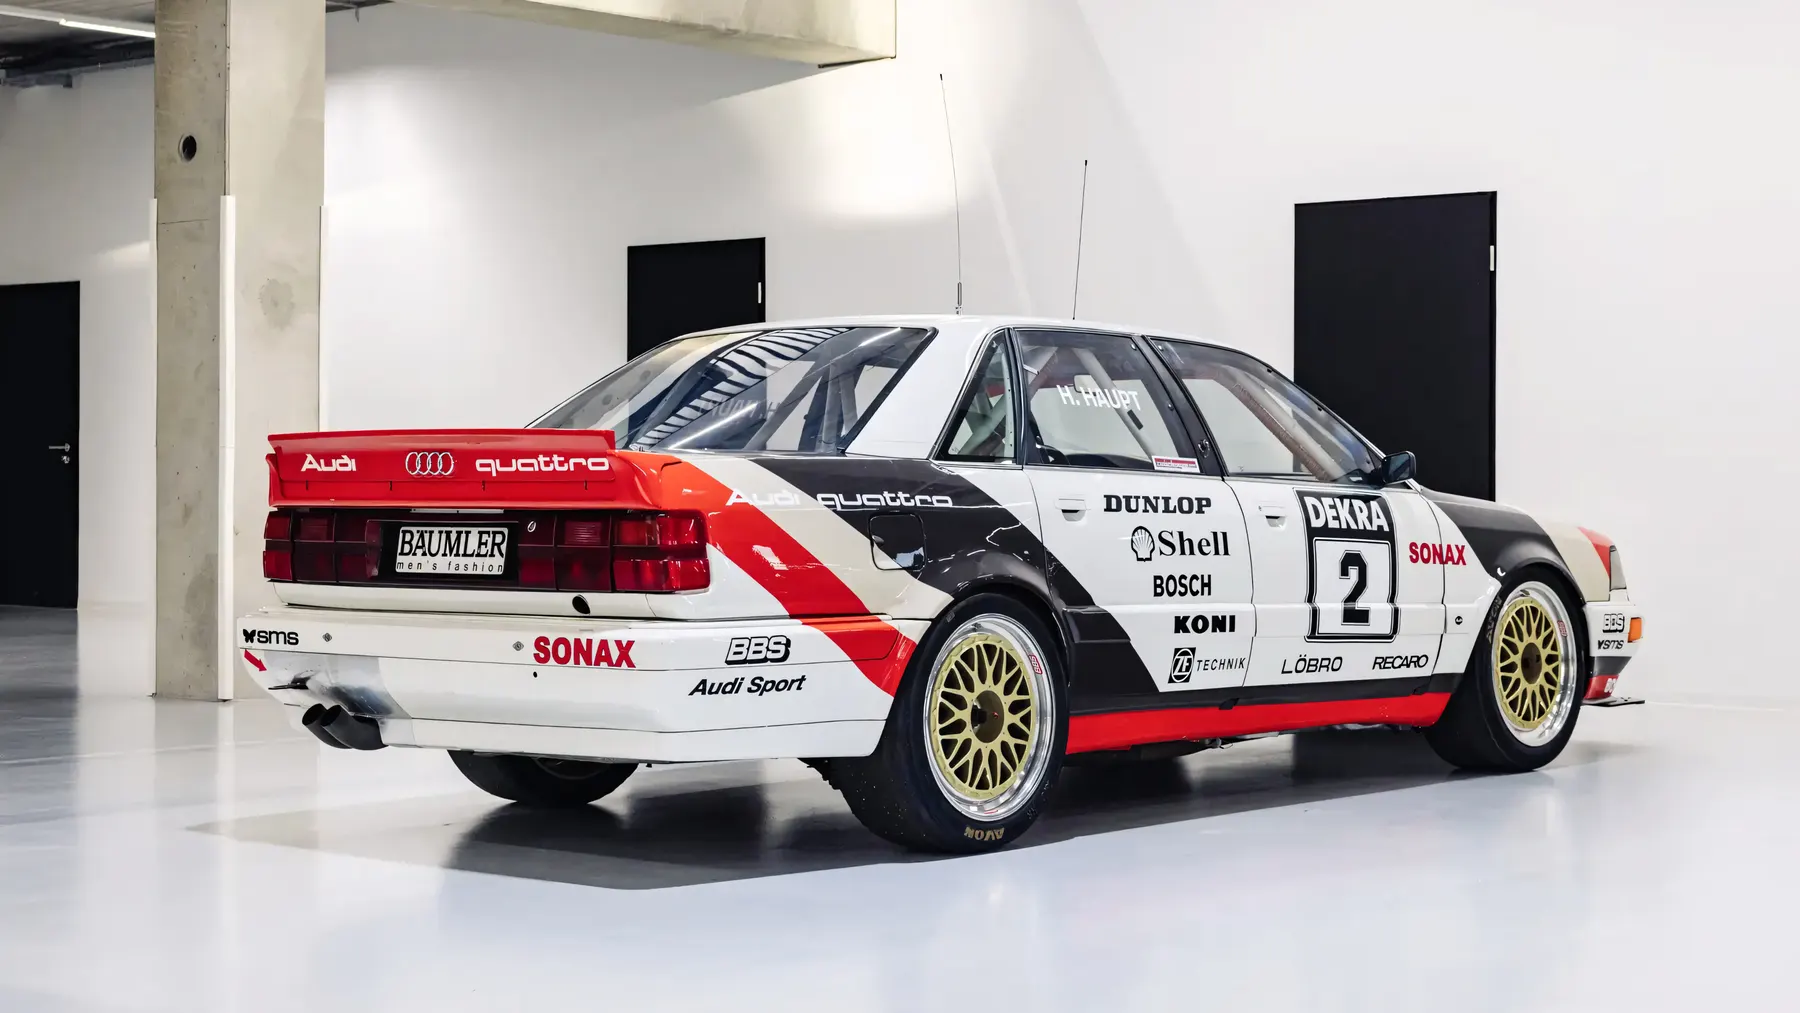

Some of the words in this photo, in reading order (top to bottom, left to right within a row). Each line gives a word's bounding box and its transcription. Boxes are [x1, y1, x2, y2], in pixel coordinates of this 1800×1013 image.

[1056, 384, 1081, 406] H.
[1079, 386, 1141, 411] HAUPT
[301, 453, 357, 472] Audi
[475, 454, 610, 477] quattro
[726, 488, 801, 506] Audi
[816, 491, 953, 511] quattro
[1103, 494, 1212, 515] DUNLOP
[1303, 496, 1390, 532] DEKRA
[398, 529, 507, 559] BÄUMLER
[1157, 529, 1231, 557] Shell
[1409, 541, 1467, 566] SONAX
[396, 560, 438, 571] men's
[447, 560, 504, 573] fashion
[1153, 573, 1212, 598] BOSCH
[1339, 549, 1371, 626] 2
[1174, 614, 1236, 634] KONI
[256, 629, 300, 646] sms
[533, 635, 637, 669] SONAX
[725, 634, 792, 666] BBS
[1172, 655, 1193, 677] ZF
[1196, 657, 1246, 672] TECHNIK
[1281, 654, 1343, 675] LÖBRO
[1372, 654, 1429, 671] RECARO
[688, 677, 746, 697] Audi
[746, 674, 807, 697] Sport
[963, 825, 1005, 842] AVON
